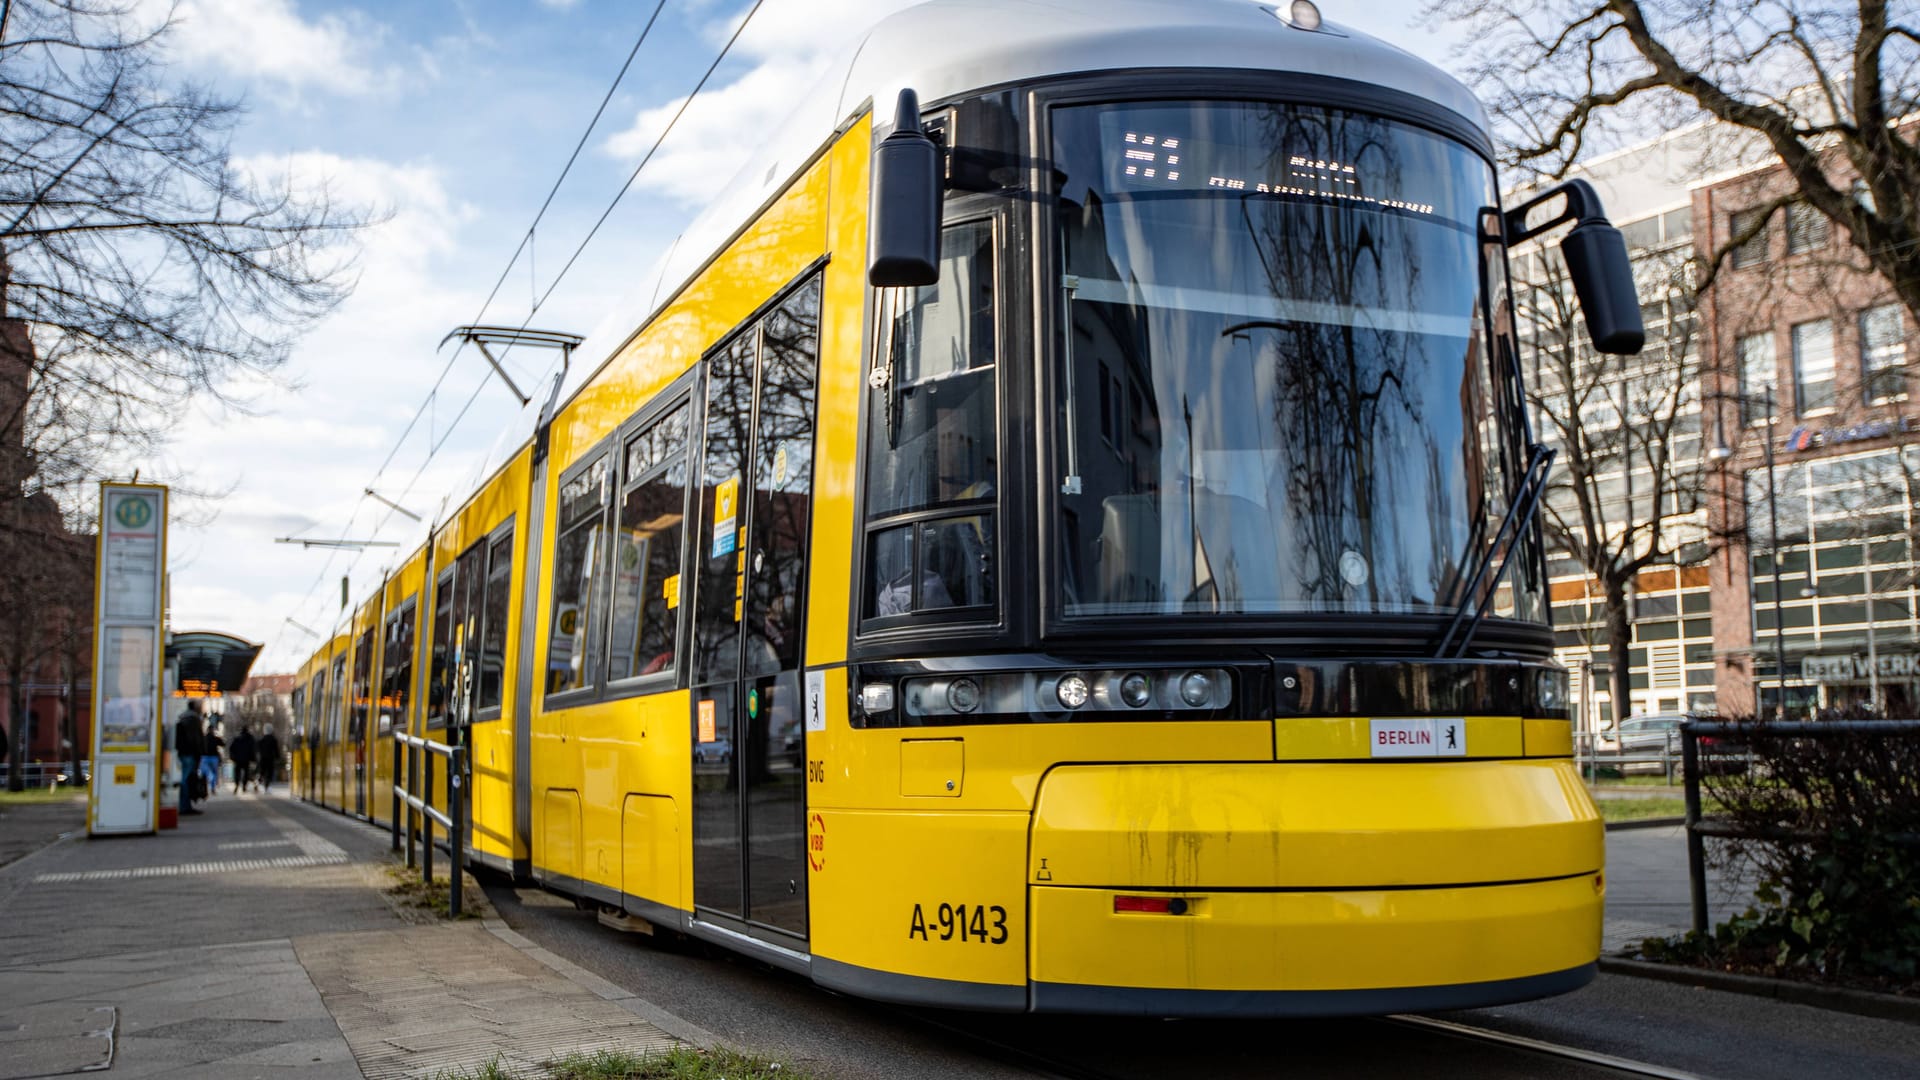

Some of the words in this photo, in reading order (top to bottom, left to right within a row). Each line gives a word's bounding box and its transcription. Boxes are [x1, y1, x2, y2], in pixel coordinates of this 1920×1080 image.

[1378, 730, 1431, 745] BERLIN
[809, 760, 824, 783] BVG
[810, 834, 824, 851] VBB
[909, 903, 1008, 944] A-9143
